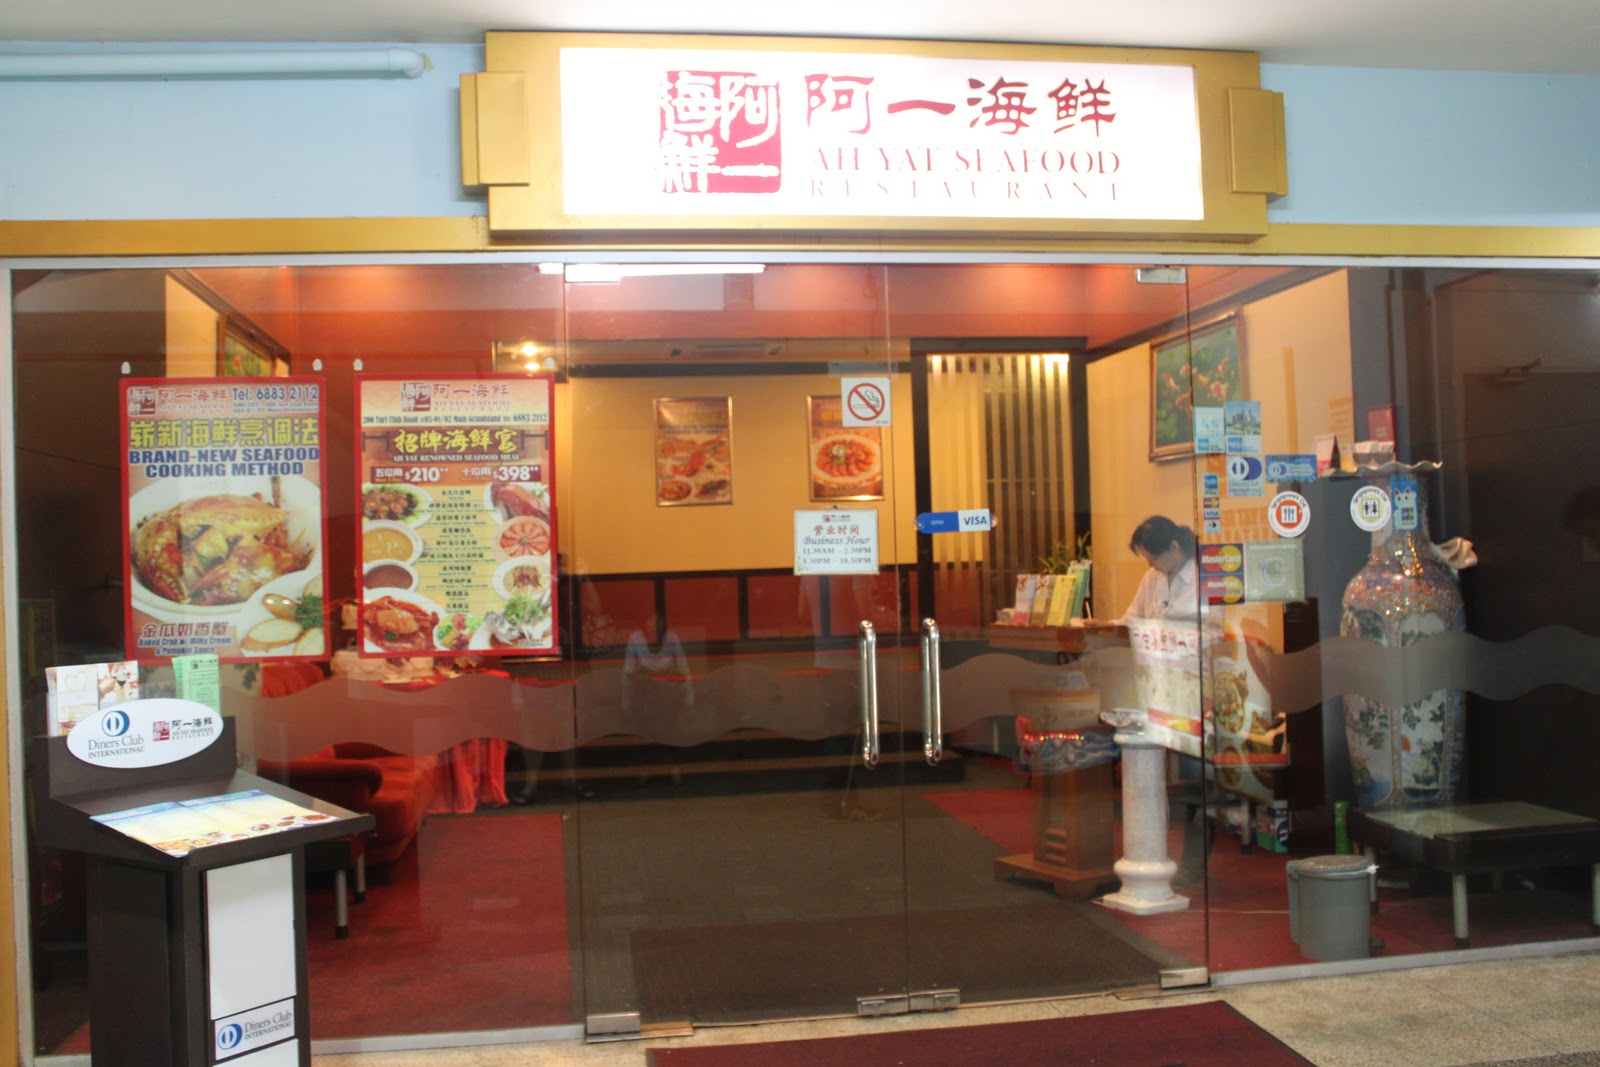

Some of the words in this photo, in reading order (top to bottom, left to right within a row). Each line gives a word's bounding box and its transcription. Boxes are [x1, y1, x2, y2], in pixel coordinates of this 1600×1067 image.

[811, 147, 860, 171] AH
[954, 148, 1120, 175] SEAFOOD
[232, 388, 252, 400] Tel:
[256, 387, 285, 400] 6883
[289, 386, 318, 399] 2112
[532, 413, 547, 421] 2112
[129, 418, 319, 448] 崭新海鲜烹调法
[129, 449, 237, 464] BRAND-NEW
[242, 447, 320, 462] SEAFOOD
[420, 454, 462, 462] RENOWNED
[145, 463, 226, 478] COOKING
[231, 462, 304, 477] METHOD
[964, 515, 987, 526] VISA
[814, 524, 859, 536] 营业时间
[803, 536, 844, 545] Business
[845, 536, 870, 545] Hour
[1202, 555, 1241, 564] MasterCard
[88, 738, 119, 751] Diners
[121, 734, 144, 747] Club
[88, 746, 144, 759] INTERNATIONAL
[245, 1019, 271, 1033] Diners
[272, 1009, 292, 1023] Club
[245, 1021, 291, 1039] INTERNATIONAL
